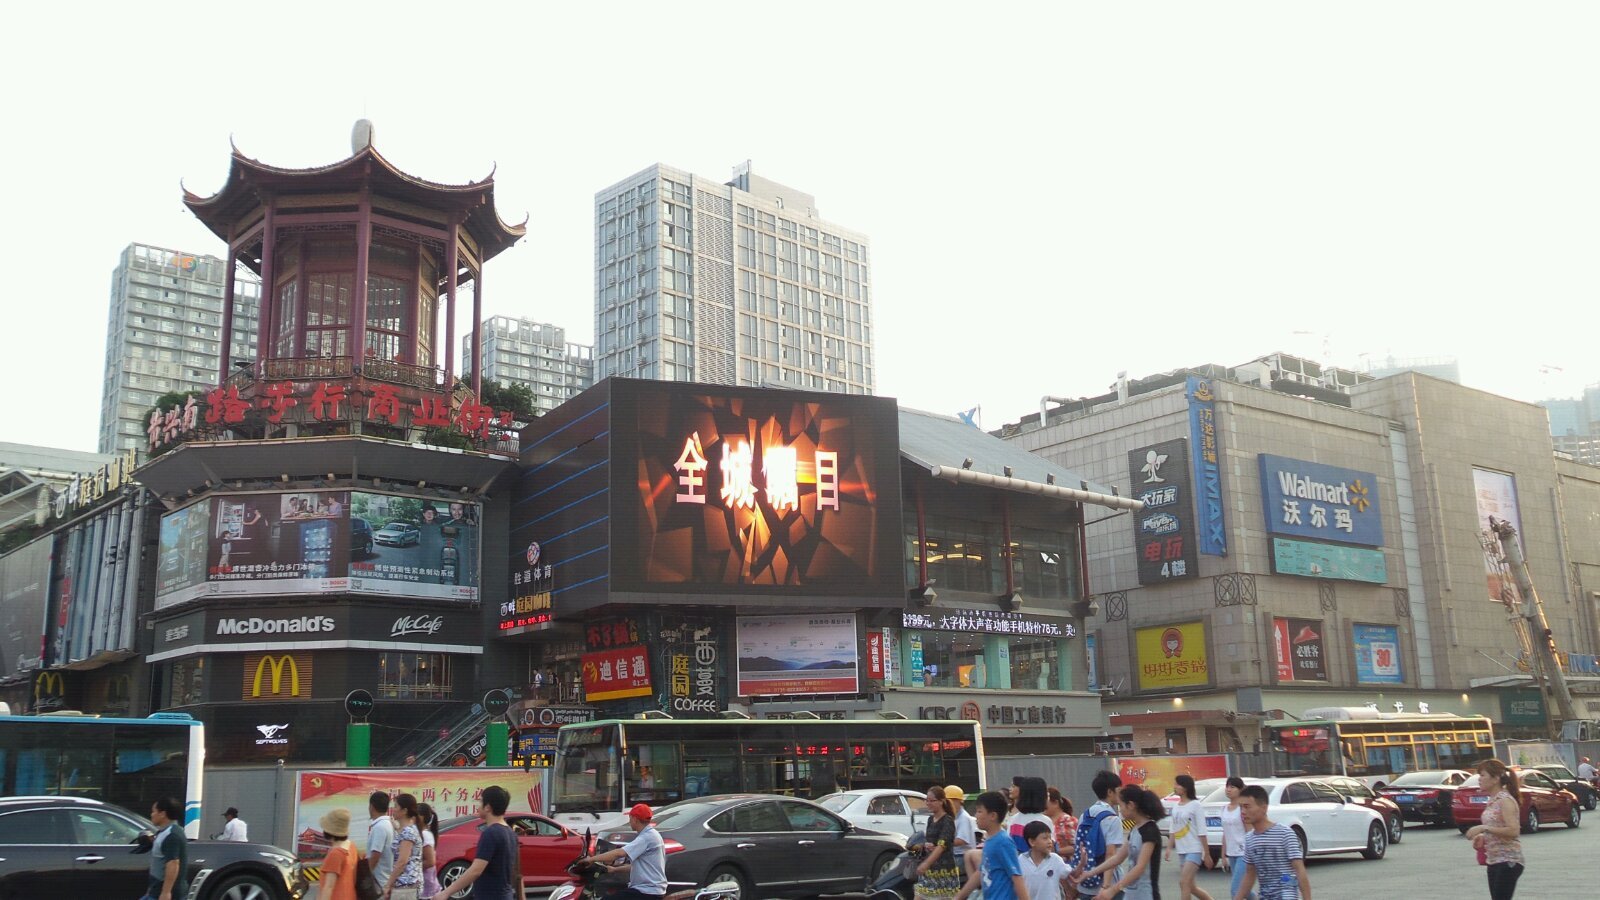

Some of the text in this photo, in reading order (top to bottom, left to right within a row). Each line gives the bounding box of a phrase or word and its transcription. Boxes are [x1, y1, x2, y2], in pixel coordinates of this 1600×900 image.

[1141, 487, 1176, 506] 大玩家
[1278, 470, 1350, 505] Walmart
[1205, 464, 1224, 545] IMAX
[1282, 499, 1353, 532] 沃尔玛
[1144, 538, 1183, 561] 电玩
[1161, 560, 1186, 578] 4楼
[216, 615, 335, 634] McDonald's
[599, 655, 646, 681] 迪信通
[1143, 657, 1206, 679] 好好香锅
[674, 698, 716, 712] COFFEE
[919, 706, 957, 720] ICBC
[988, 704, 1067, 724] 中国工商银行
